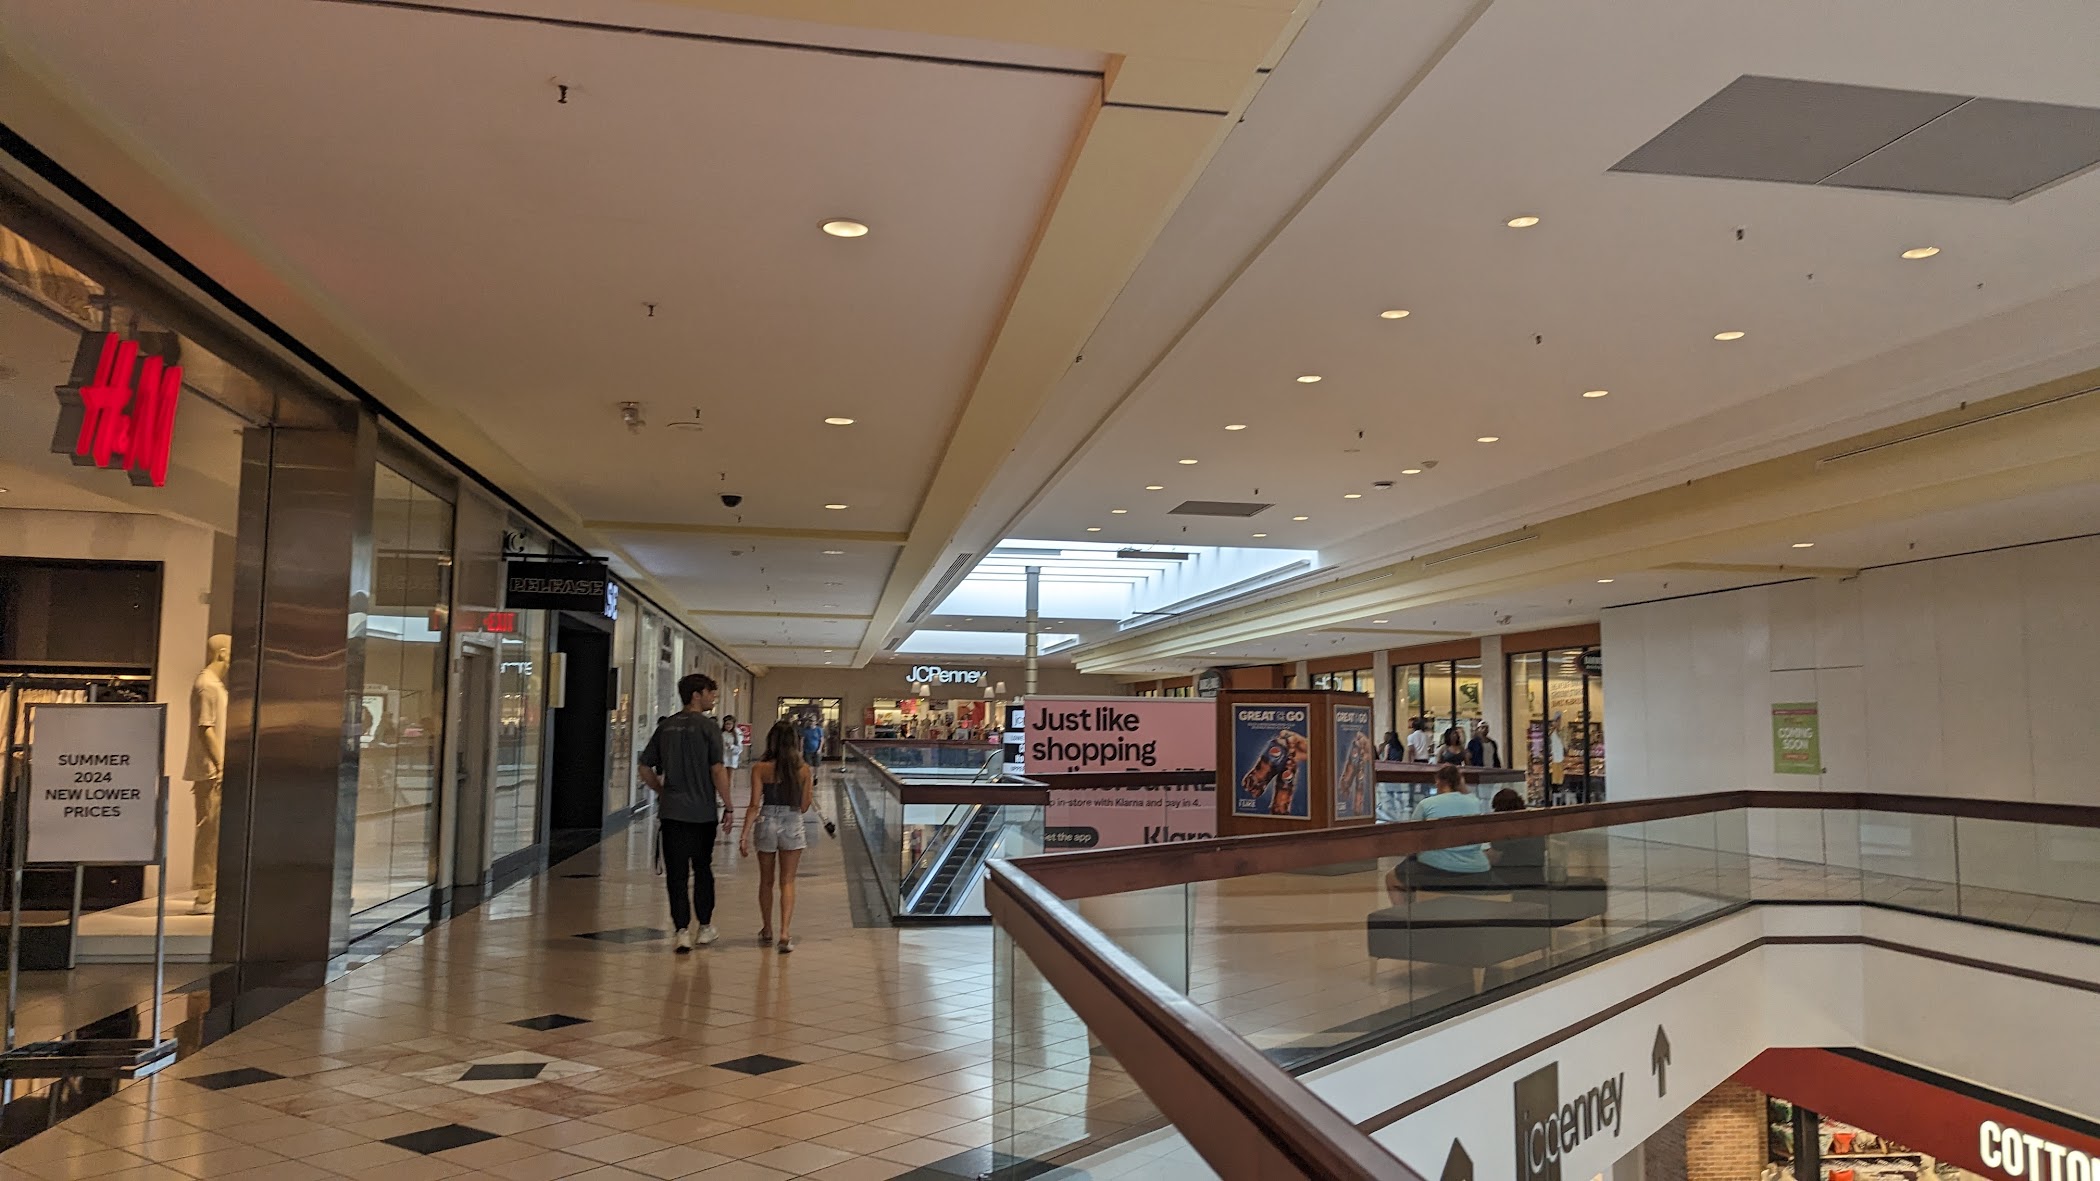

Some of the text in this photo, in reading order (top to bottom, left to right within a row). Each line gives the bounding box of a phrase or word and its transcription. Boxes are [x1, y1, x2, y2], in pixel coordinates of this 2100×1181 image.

[1032, 706, 1140, 732] Just like
[1238, 711, 1275, 721] GREAT
[1286, 711, 1305, 721] GO
[1777, 727, 1813, 738] COMING
[1782, 739, 1808, 750] SOON
[1032, 736, 1157, 766] shopping
[58, 754, 130, 766] SUMMER
[74, 772, 112, 783] 2024
[45, 789, 140, 800] NEW LOWER
[1057, 798, 1092, 807] in-store
[1095, 798, 1113, 807] with
[1115, 798, 1144, 807] Klarna
[1145, 798, 1163, 807] and
[1165, 799, 1181, 809] pay
[1182, 798, 1191, 807] in
[64, 806, 121, 817] PRICES
[1057, 832, 1073, 842] the
[1073, 834, 1092, 844] app
